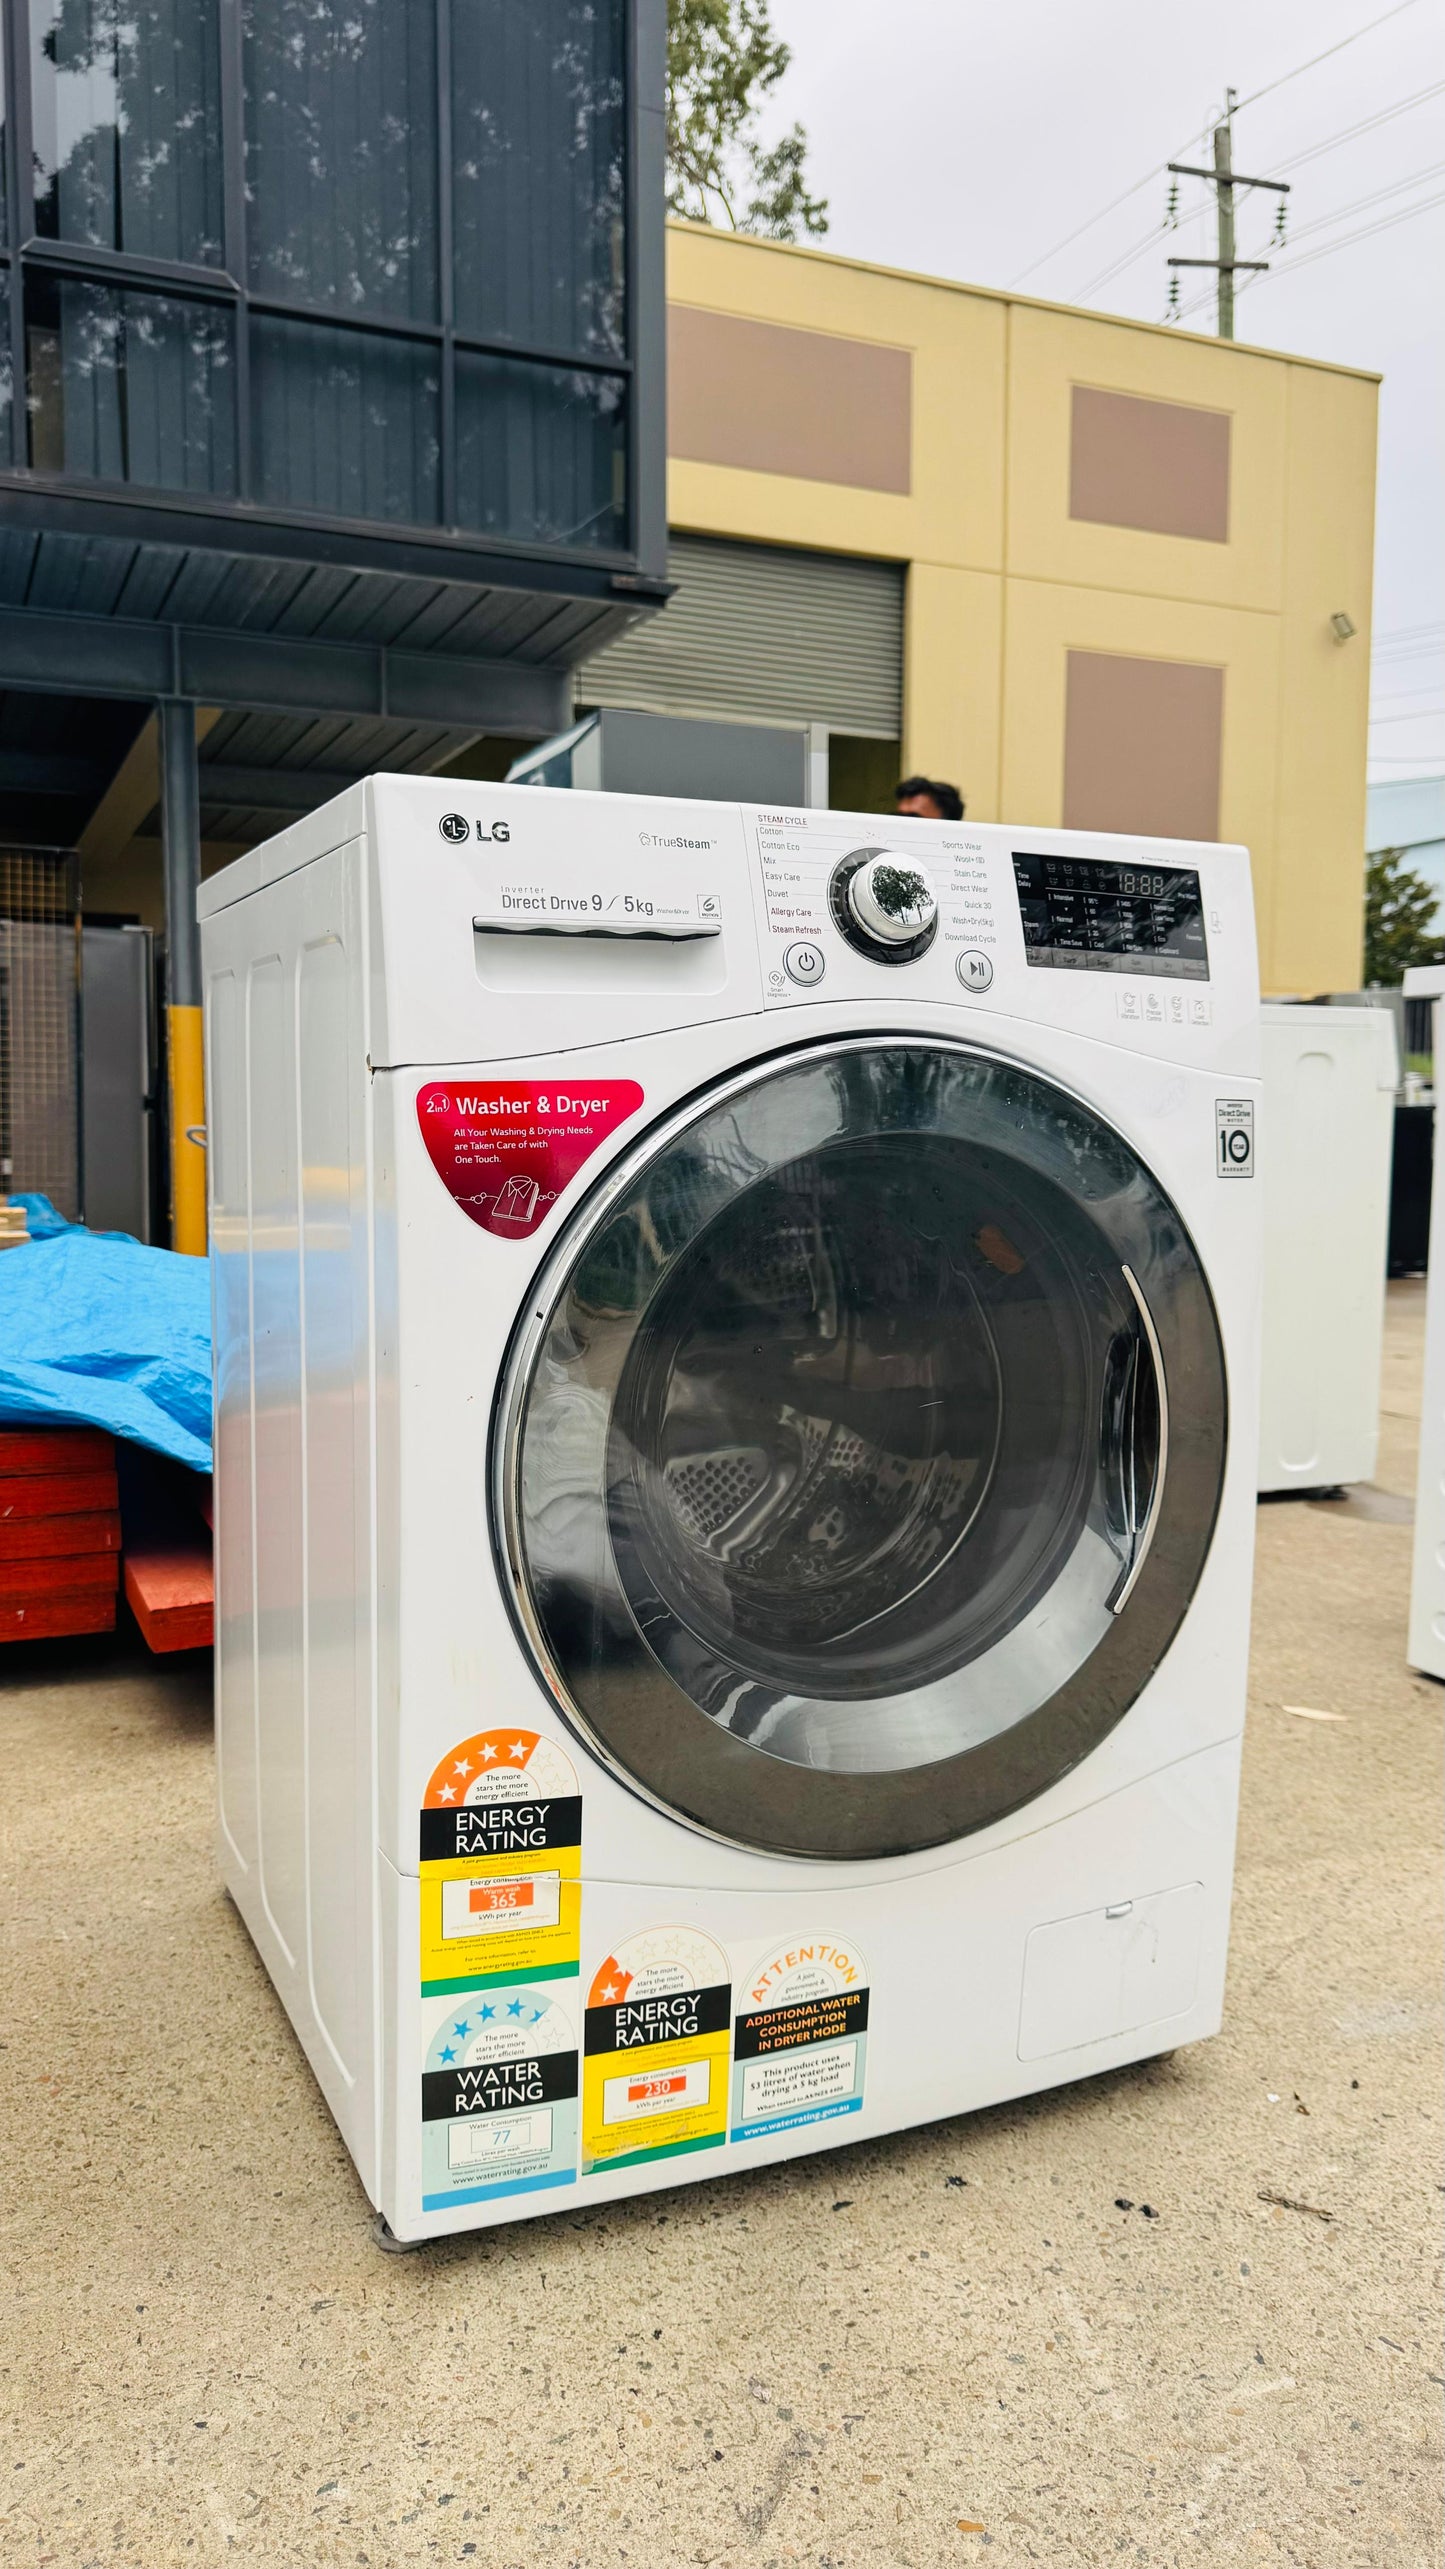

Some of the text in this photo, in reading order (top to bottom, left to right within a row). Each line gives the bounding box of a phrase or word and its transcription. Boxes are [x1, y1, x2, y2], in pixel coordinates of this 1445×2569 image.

[757, 814, 807, 825] STEAM CYCLE
[476, 820, 510, 842] LG
[759, 827, 784, 836] Cotton
[761, 841, 800, 851] Cotton Eco
[942, 841, 982, 851] Sports Wear
[765, 872, 801, 881] Easy Care
[954, 869, 987, 879] Stain Care
[500, 886, 545, 894] Inverter
[767, 889, 789, 898] Duvet
[951, 883, 988, 893] Direct Wear
[502, 895, 547, 910] Direct
[550, 896, 588, 911] Drive
[591, 894, 603, 911] 9
[624, 895, 654, 916] 5kg
[771, 907, 812, 917] Allergy Care
[964, 901, 982, 909] Quick
[772, 925, 822, 935] Steam Refresh
[944, 933, 996, 943] Download Cycle
[456, 1095, 610, 1118] Washer & Dryer
[1218, 1109, 1236, 1117] Direct
[454, 1126, 593, 1138] All Your Washing & Drying Needs
[454, 1140, 549, 1151] are Taken Care of with
[1220, 1129, 1250, 1163] 10
[455, 1155, 502, 1164] One Touch.
[475, 1790, 529, 1801] energy efficient
[456, 1805, 550, 1831] ENERGY
[456, 1827, 546, 1854] RATING
[470, 1879, 492, 1887] Energy
[490, 1892, 517, 1909] 365
[479, 1912, 494, 1921] kWh
[496, 1912, 507, 1920] per
[751, 1945, 858, 2003] ATTENTION
[658, 1983, 684, 1991] efficient
[616, 1994, 701, 2027] ENERGY
[746, 1994, 860, 2028] ADDITIONAL WATER
[759, 2010, 847, 2037] CONSUMPTION
[616, 2016, 698, 2048] RATING
[758, 2022, 847, 2051] IN DRYER MODE
[507, 2040, 526, 2048] more
[498, 2049, 525, 2058] efficient
[763, 2055, 840, 2078] This product uses
[457, 2061, 542, 2090] WATER
[629, 2067, 687, 2084] Energy consumption
[750, 2061, 851, 2091] 53 litres of water when
[644, 2080, 671, 2098] 230
[761, 2085, 790, 2098] drying
[800, 2080, 806, 2088] 5
[808, 2077, 818, 2087] kg
[821, 2072, 839, 2083] load
[455, 2082, 543, 2112] RATING
[469, 2116, 532, 2130] Water Consumption
[743, 2104, 850, 2137] www.waterrating.gov.au
[492, 2130, 511, 2145] 77
[452, 2163, 548, 2185] www.waterrating.gov.au
